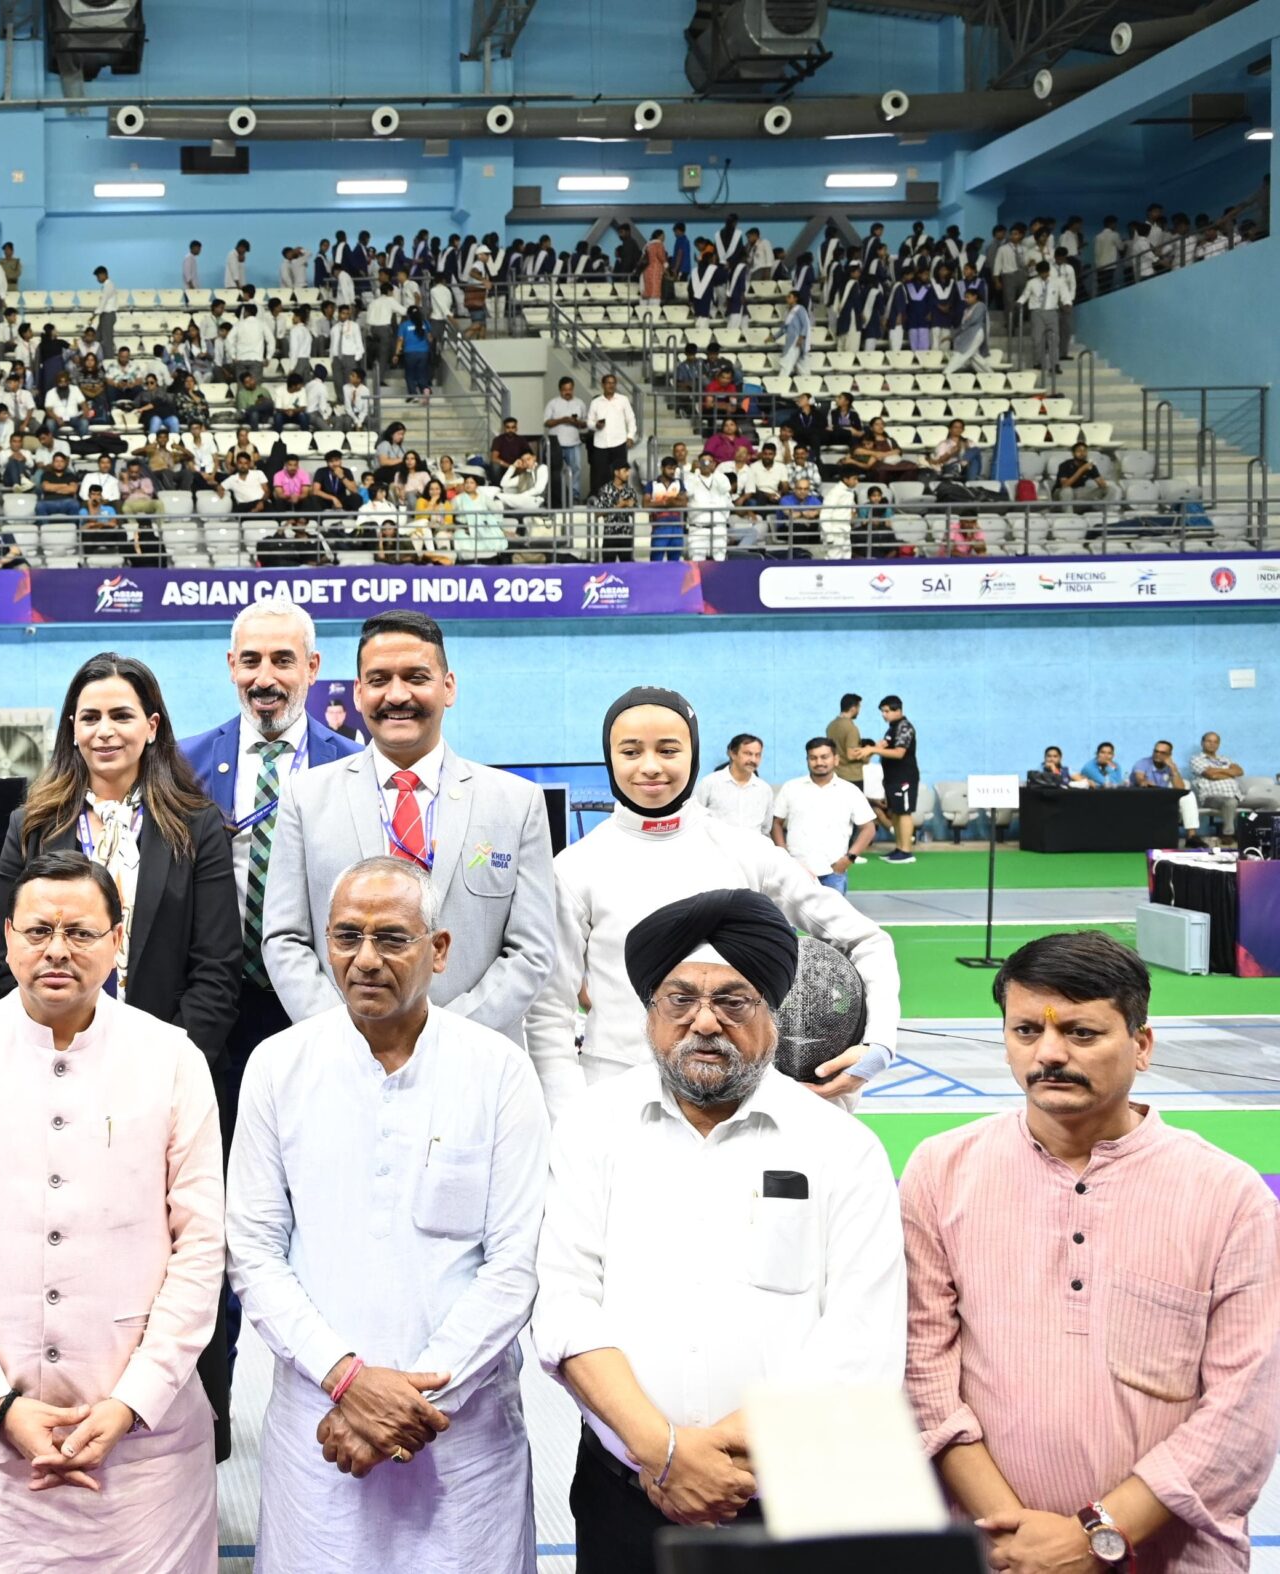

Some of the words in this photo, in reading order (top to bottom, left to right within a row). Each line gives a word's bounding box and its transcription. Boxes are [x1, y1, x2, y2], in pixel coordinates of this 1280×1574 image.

[1065, 572, 1107, 581] FENCING
[922, 577, 951, 593] SAI
[1065, 584, 1093, 593] INDIA
[1138, 584, 1157, 595] FIE
[161, 581, 249, 605] ASIAN
[253, 579, 347, 604] CADET
[351, 578, 407, 602] CUP
[412, 578, 488, 602] INDIA
[493, 578, 562, 602] 2025
[491, 852, 511, 862] KHELO
[491, 860, 509, 869] INDIA
